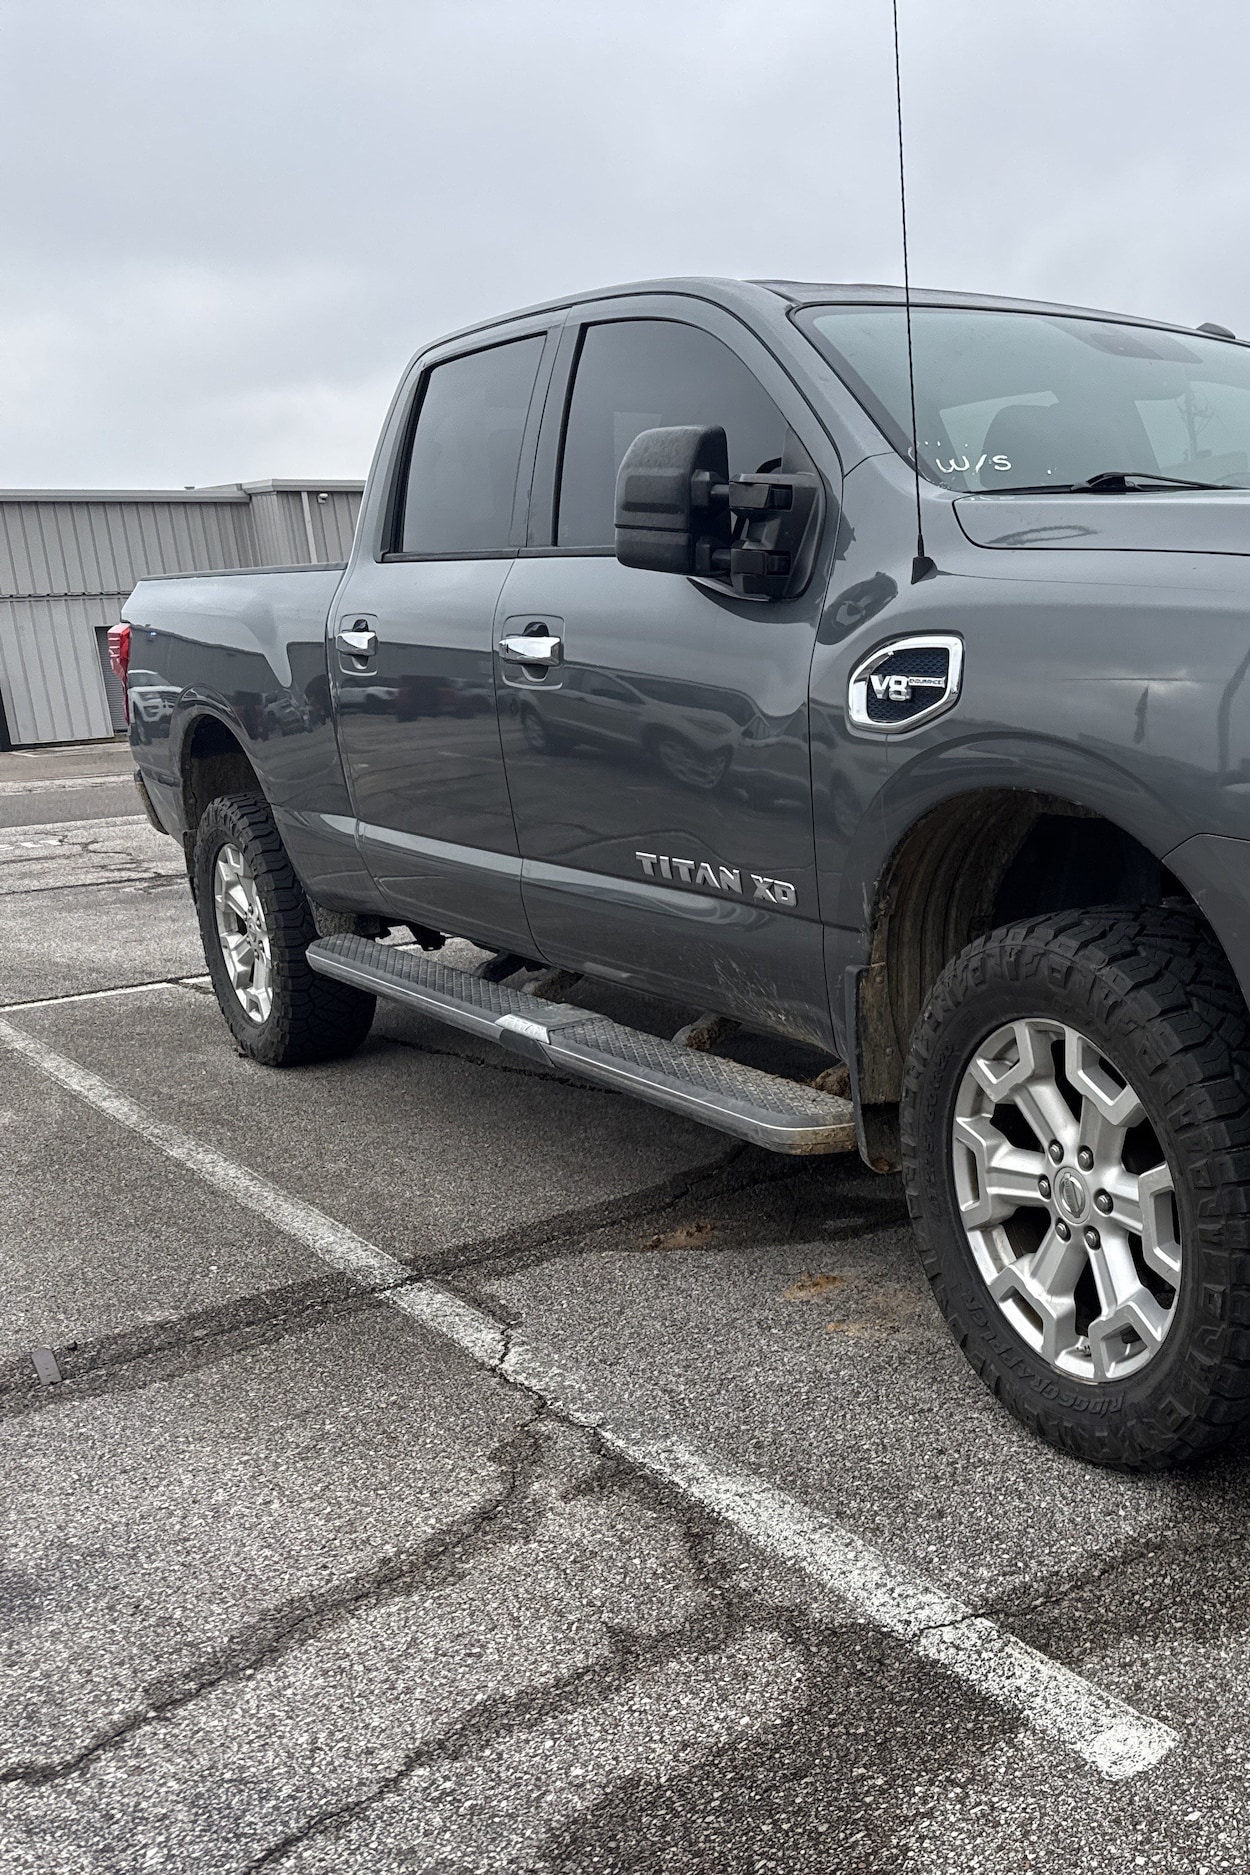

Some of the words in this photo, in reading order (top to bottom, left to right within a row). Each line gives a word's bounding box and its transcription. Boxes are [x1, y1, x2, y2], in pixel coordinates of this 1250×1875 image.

[869, 674, 911, 701] V8
[635, 851, 743, 895] TITAN
[750, 873, 798, 907] XD
